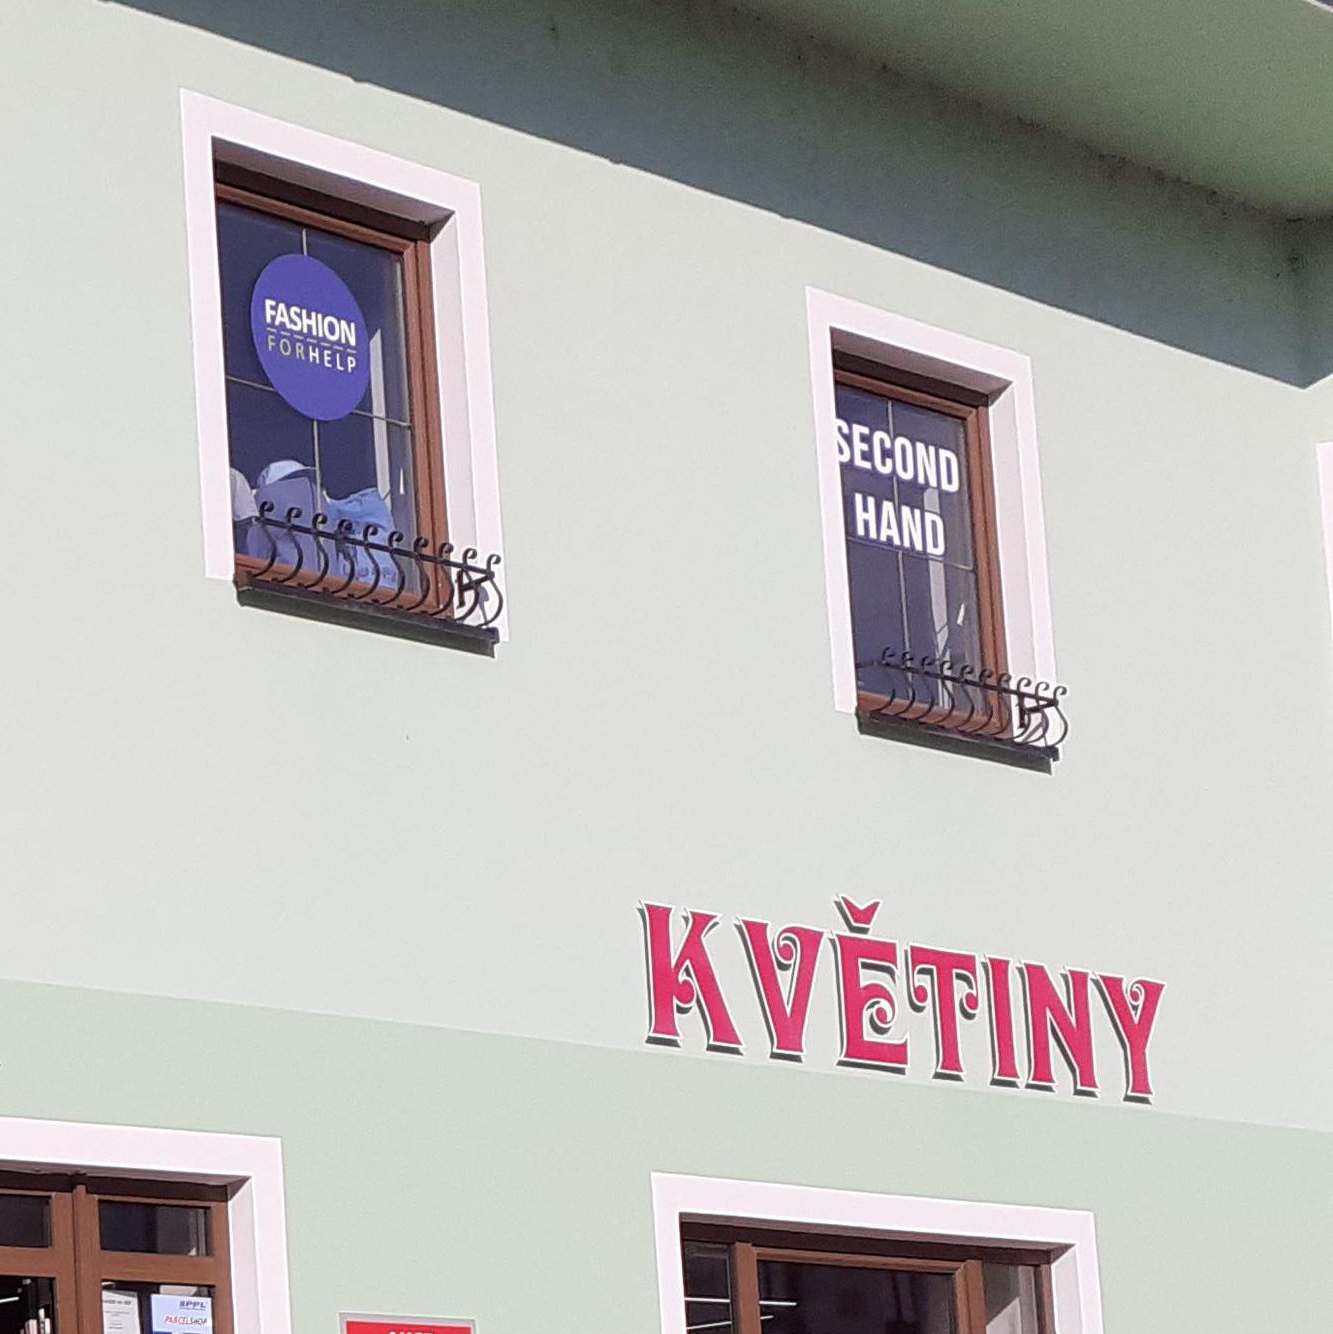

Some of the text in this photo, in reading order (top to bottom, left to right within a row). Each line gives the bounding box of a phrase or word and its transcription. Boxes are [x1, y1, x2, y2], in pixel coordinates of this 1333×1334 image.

[265, 298, 356, 347] FASHION
[834, 418, 960, 493] SECOND
[853, 493, 946, 557] HAND
[637, 894, 1166, 1105] KVĚTINY
